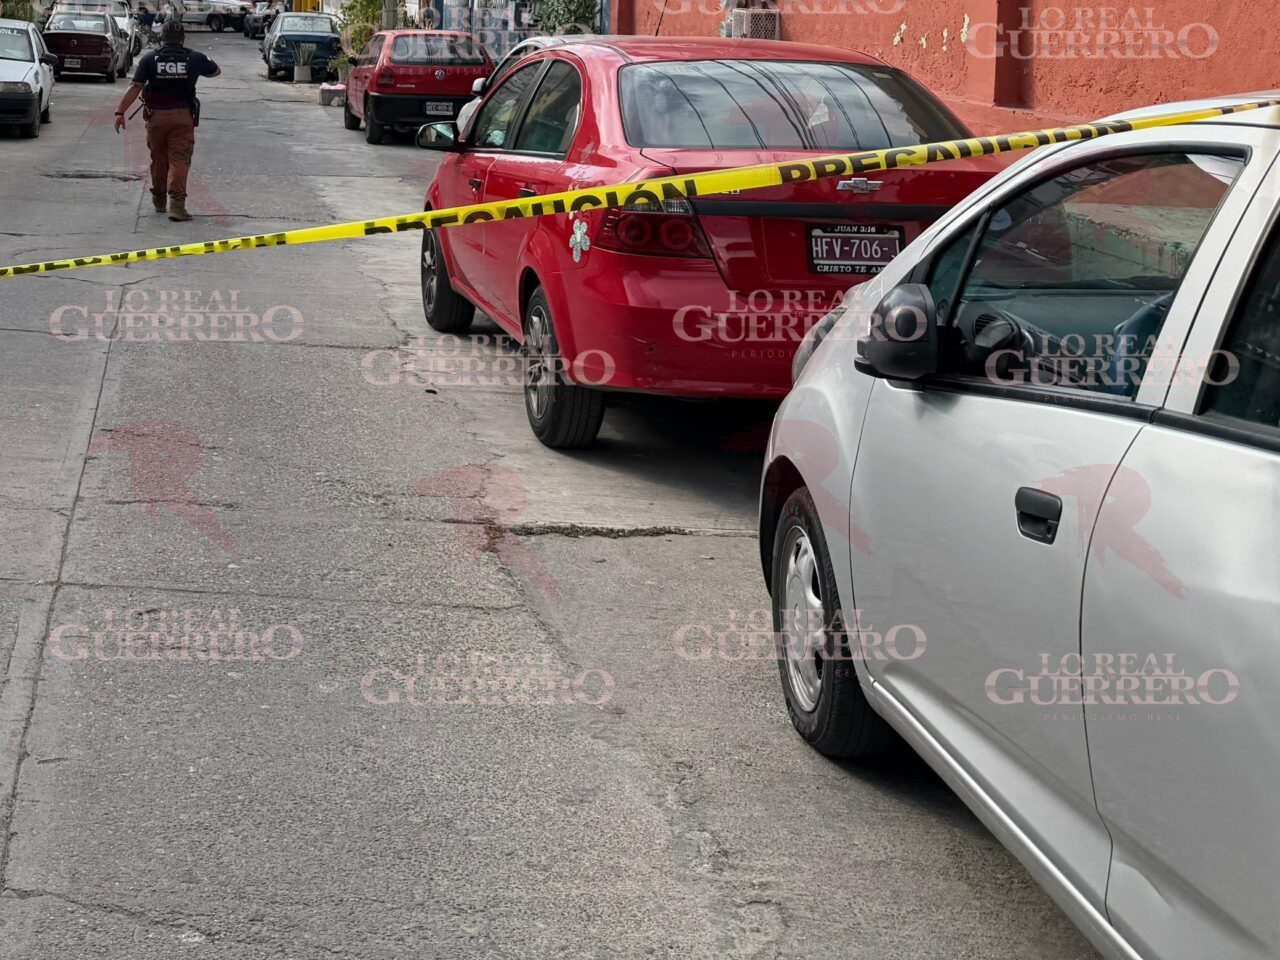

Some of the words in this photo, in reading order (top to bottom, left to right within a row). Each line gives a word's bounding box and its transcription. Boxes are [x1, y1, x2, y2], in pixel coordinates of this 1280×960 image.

[156, 62, 187, 74] FGE
[811, 237, 900, 258] HFV-706-J
[816, 265, 852, 273] CRISTO
